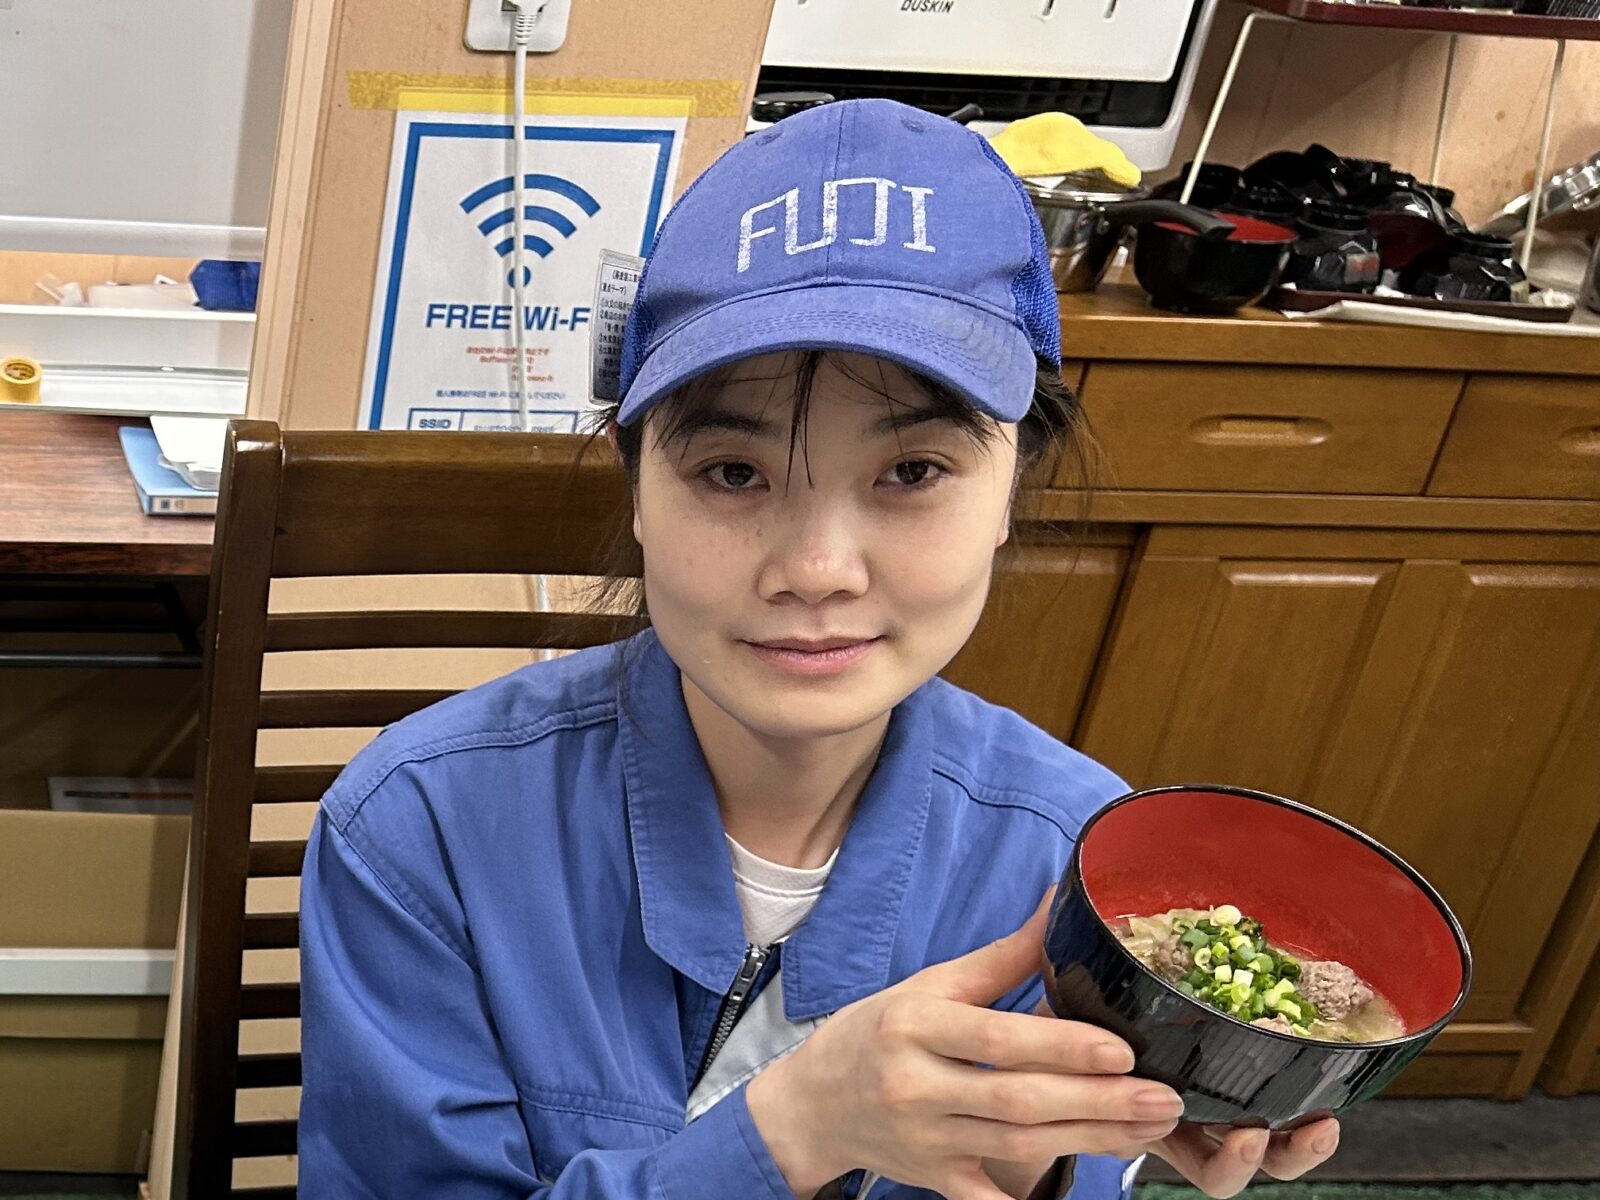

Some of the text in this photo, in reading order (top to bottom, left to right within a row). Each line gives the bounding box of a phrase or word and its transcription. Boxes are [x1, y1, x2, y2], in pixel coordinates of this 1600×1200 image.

[900, 0, 954, 13] DUSKIN
[736, 177, 937, 273] FUJI
[425, 303, 513, 331] FREE
[523, 305, 592, 332] Wi-F
[419, 418, 452, 430] SSID
